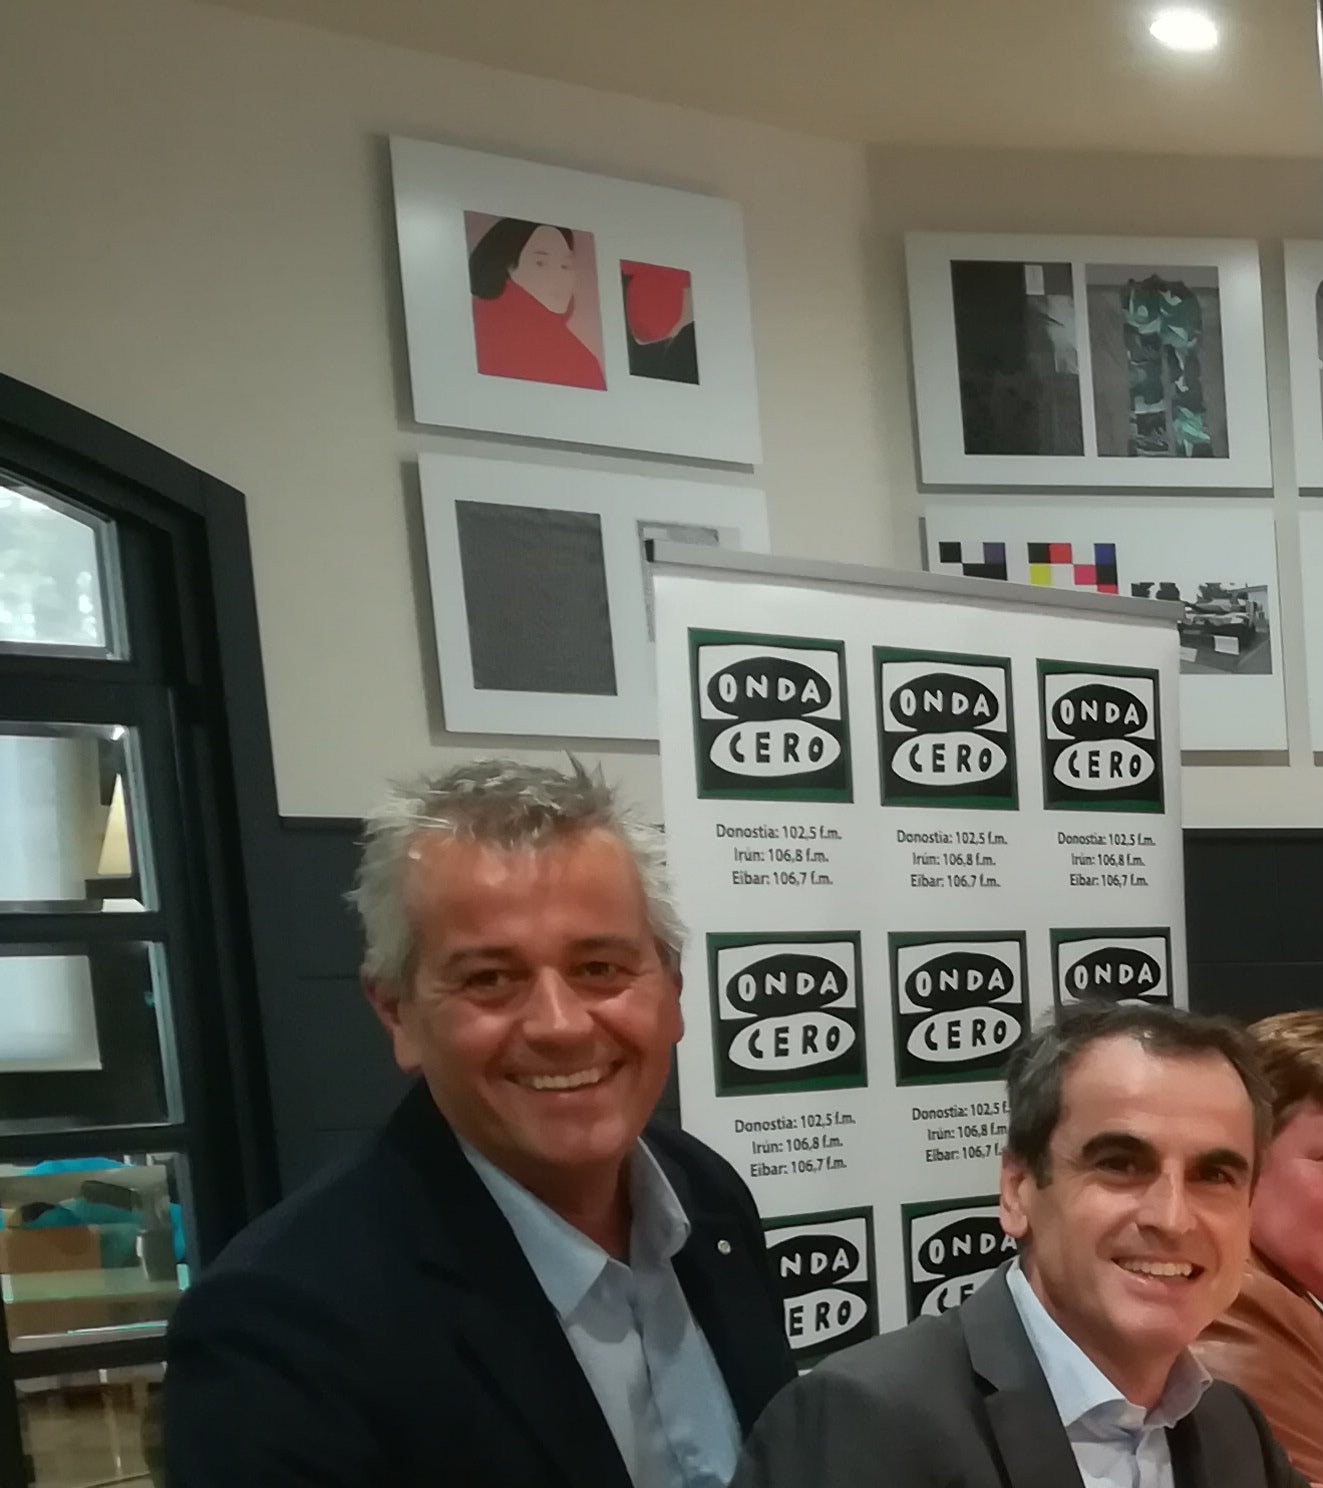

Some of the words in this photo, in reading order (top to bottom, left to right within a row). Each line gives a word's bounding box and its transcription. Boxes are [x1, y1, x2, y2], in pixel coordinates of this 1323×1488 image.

[718, 673, 821, 703] ONDA
[900, 688, 991, 717] ONDA
[1060, 698, 1140, 725] ONDA
[729, 731, 824, 763] CERO
[909, 743, 992, 773] CERO
[1068, 749, 1142, 779] CERO
[716, 823, 779, 839] Donostia:
[782, 825, 817, 840] 102,5
[896, 829, 953, 844] Donostia:
[731, 870, 770, 885] Eibar:
[910, 873, 944, 888] Eibar:
[738, 971, 839, 1002] ONDA
[915, 968, 1004, 997] ONDA
[1074, 962, 1153, 990] ONDA
[748, 1023, 841, 1059] CERO
[924, 1019, 1007, 1051] CERO
[734, 1115, 798, 1133] Donostia:
[800, 1113, 833, 1129] 102,5
[911, 1104, 969, 1121] Donostia:
[970, 1102, 1000, 1117] 102,5
[785, 1136, 821, 1153] 106,8
[957, 1124, 988, 1139] 106,8
[925, 1148, 960, 1163] Eibar:
[961, 1144, 992, 1160] 106,7
[750, 1160, 789, 1178] Eibar:
[790, 1158, 824, 1174] 106,7
[928, 1231, 1018, 1265] ONDA
[780, 1247, 851, 1278] NDA
[788, 1300, 851, 1337] ERO
